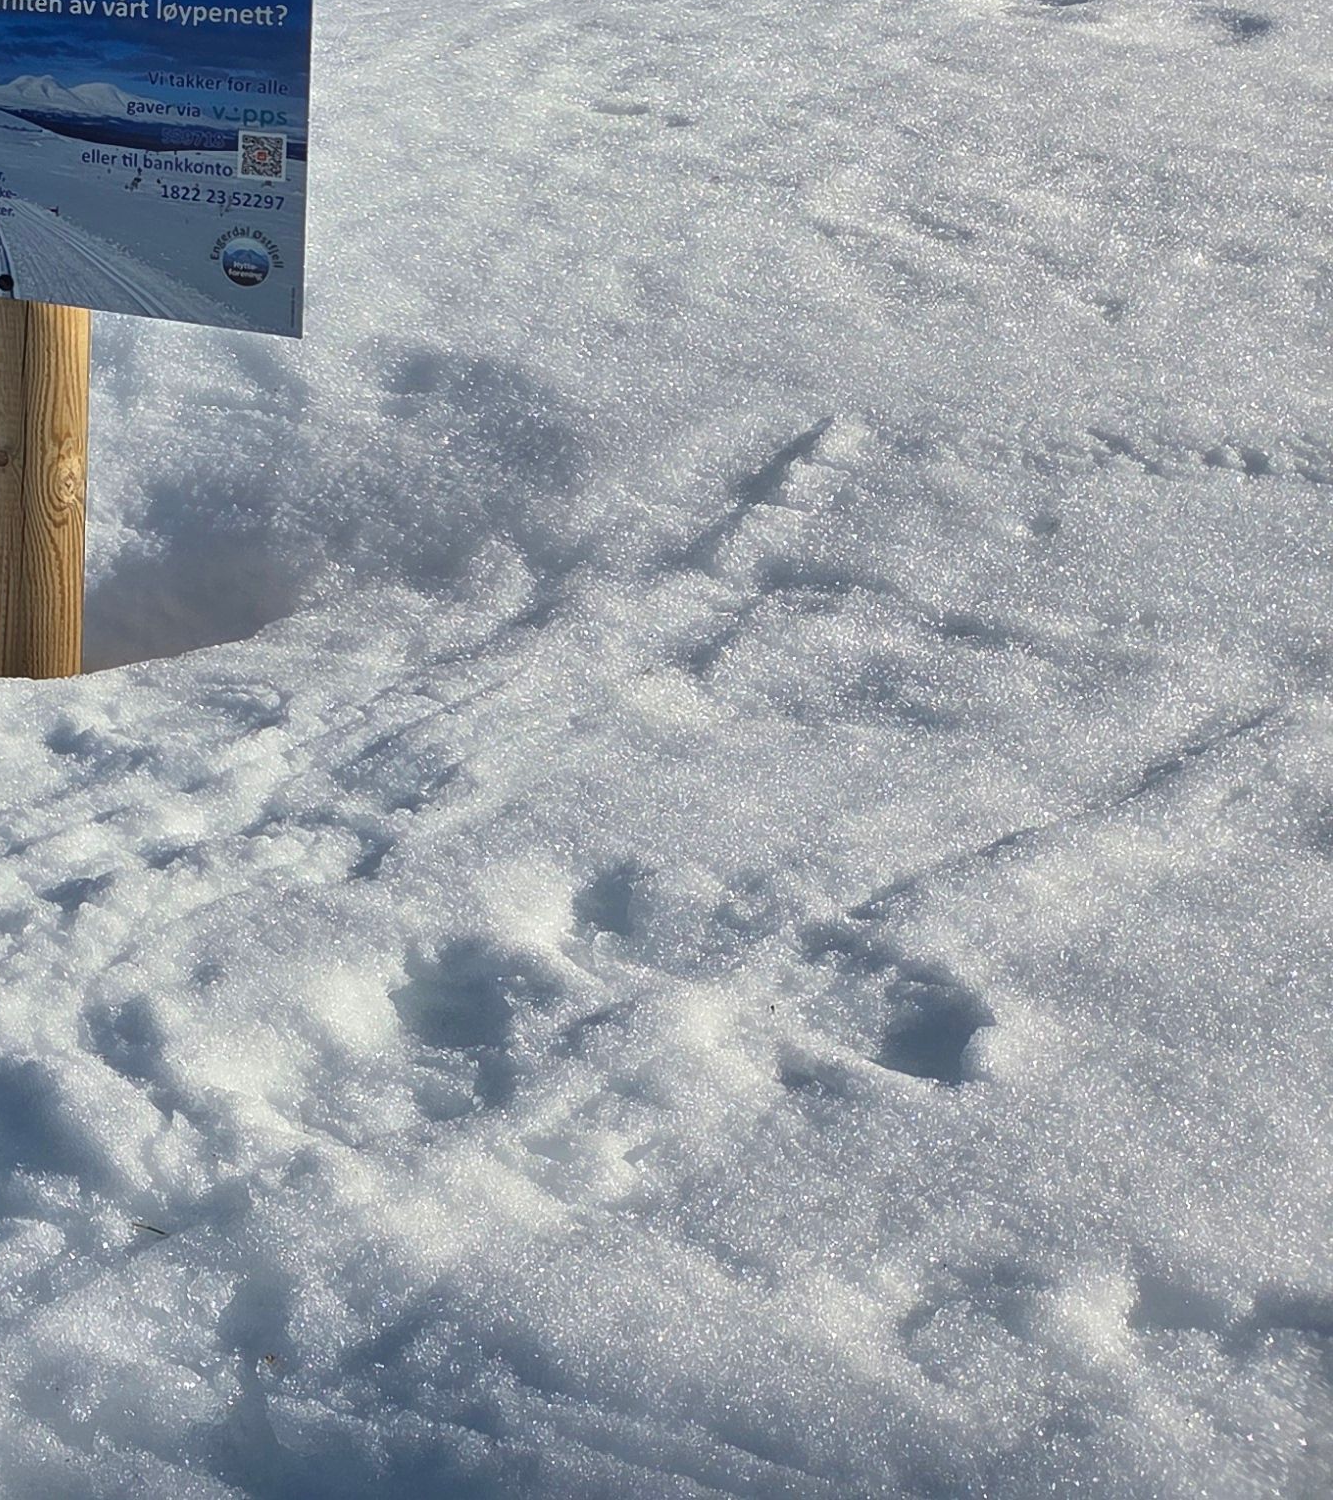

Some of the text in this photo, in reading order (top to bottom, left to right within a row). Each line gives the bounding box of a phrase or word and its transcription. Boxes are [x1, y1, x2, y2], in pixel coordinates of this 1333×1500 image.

[68, 0, 96, 15] av
[148, 71, 289, 96] Vi takker for alle
[126, 100, 288, 127] gaver via vipps
[82, 149, 233, 178] eller til bankkonto
[160, 184, 285, 211] 1822 23 52297
[209, 226, 250, 260] Engerdal
